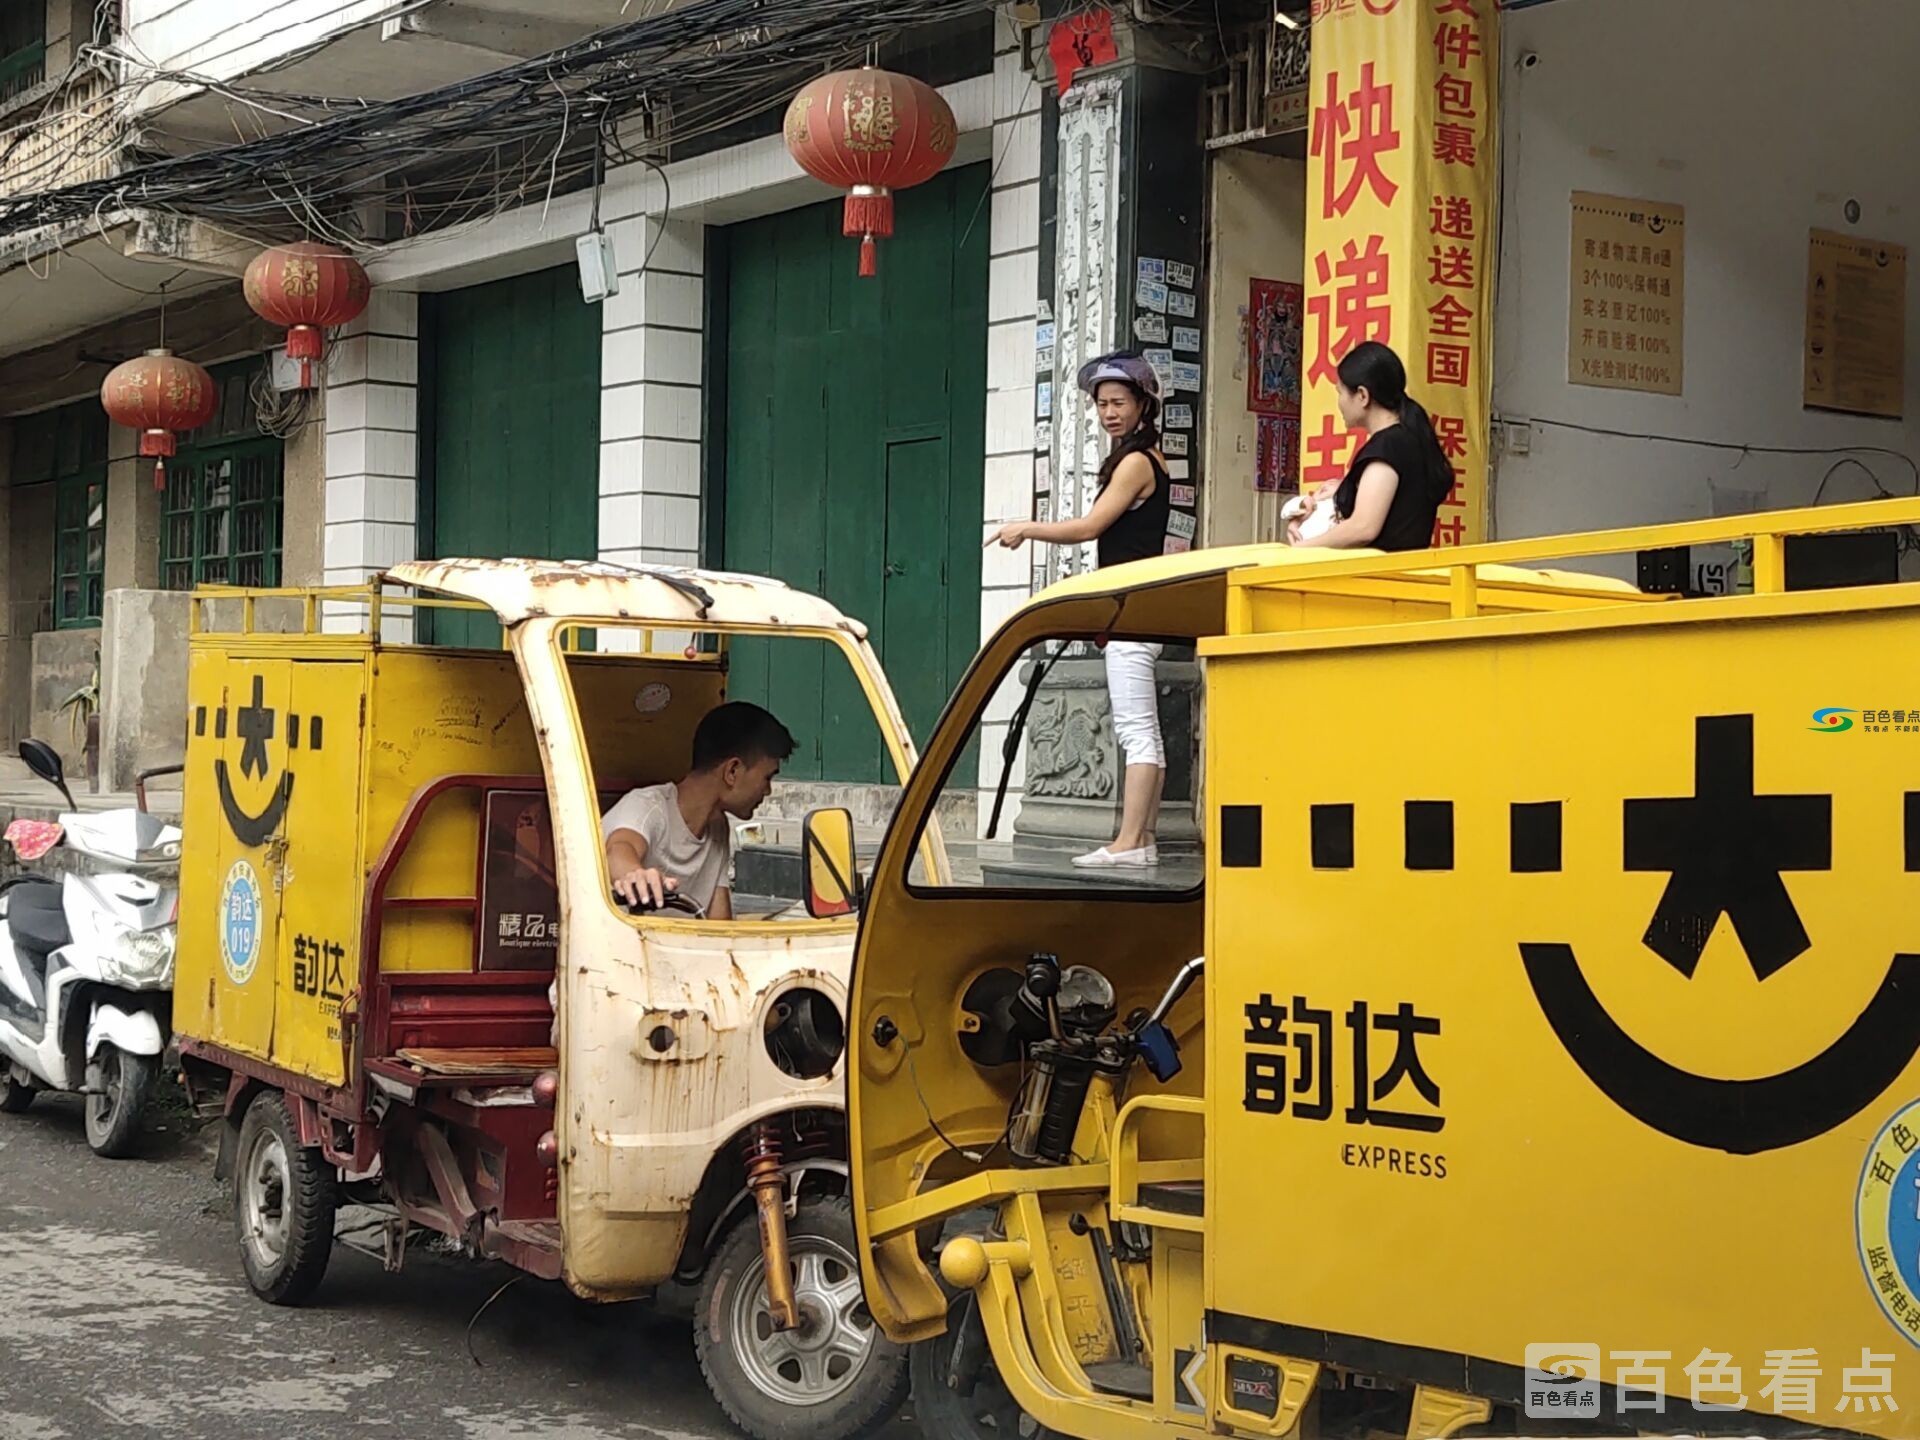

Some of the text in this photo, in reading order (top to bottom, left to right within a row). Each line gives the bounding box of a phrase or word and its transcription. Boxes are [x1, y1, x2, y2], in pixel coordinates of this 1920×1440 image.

[1427, 195, 1474, 388] 递送全国
[1582, 297, 1672, 326] 实名登记100%
[231, 893, 253, 921] 韵达
[231, 926, 252, 953] 019
[293, 932, 345, 1002] 韵达
[1242, 993, 1446, 1133] 韵达
[1342, 1143, 1447, 1179] EXPRESS
